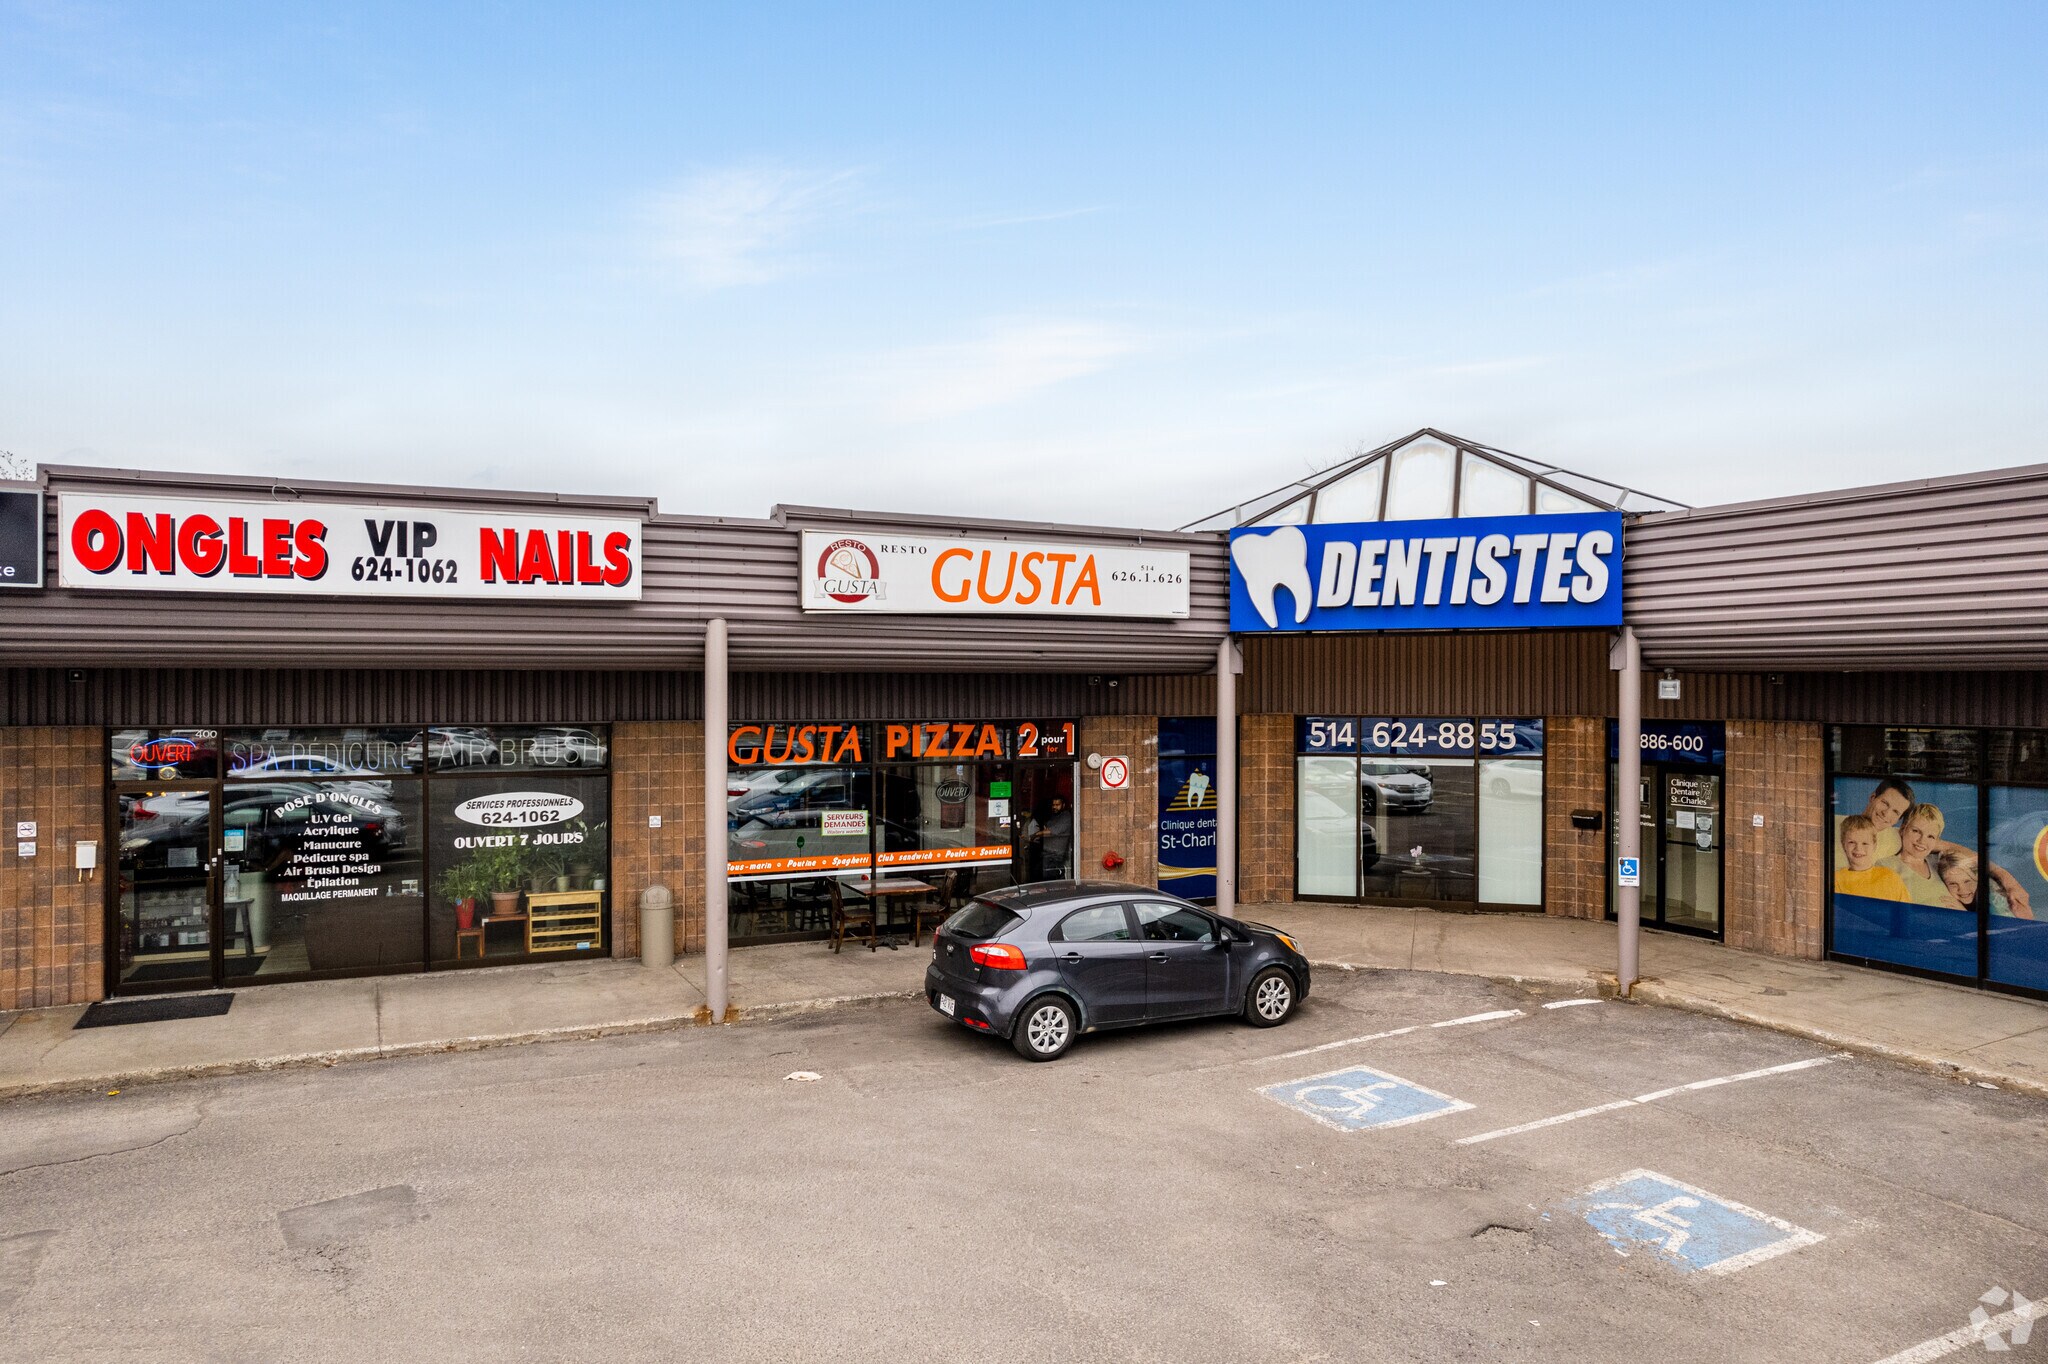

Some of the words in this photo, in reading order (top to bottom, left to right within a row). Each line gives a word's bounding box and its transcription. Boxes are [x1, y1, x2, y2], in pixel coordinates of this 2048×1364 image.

[364, 518, 438, 559] VIP
[830, 540, 866, 552] RESTO
[71, 509, 328, 580] ONGLES
[480, 527, 632, 587] NAILS
[881, 544, 927, 555] RESTO
[351, 556, 458, 583] 624-1062
[1317, 530, 1614, 607] DENTISTES
[931, 547, 1102, 606] GUSTA
[1112, 571, 1182, 583] 626.1.626
[824, 579, 878, 594] GUSTA
[195, 729, 217, 739] 400
[1018, 722, 1038, 757] 2
[1041, 736, 1065, 746] pour
[1062, 722, 1075, 756] 1
[1309, 722, 1355, 747] 514
[1372, 722, 1517, 749] 624-8855
[728, 725, 862, 765] GUSTA
[887, 722, 1004, 759] PIZZA
[1640, 733, 1703, 751] 886-600
[130, 744, 193, 762] OUVERT
[232, 743, 279, 773] SPA
[438, 737, 487, 767] AIR
[501, 737, 600, 767] BRUSH
[1671, 779, 1698, 789] Clinique
[1671, 787, 1700, 796] Dentaire
[940, 787, 968, 797] OUVERT
[274, 795, 313, 818] POSE
[316, 792, 382, 815] D'ONGLES
[466, 800, 505, 809] SERVICES
[506, 798, 574, 808] PROFESSIONNELS
[333, 814, 352, 822] Gel
[481, 810, 560, 824] 624-1062
[1161, 820, 1195, 831] Clinique
[1197, 818, 1218, 828] dent
[303, 825, 359, 837] Acrylique
[304, 841, 362, 850] Manucure
[454, 835, 515, 849] OUVERT
[520, 834, 529, 845] 7
[533, 832, 584, 845] JOURS
[1161, 831, 1216, 849] St-Charl
[293, 853, 346, 863] Pédicure
[349, 853, 369, 861] spa
[787, 859, 816, 867] Poutine
[832, 856, 869, 866] Spaghetti
[877, 854, 894, 862] Club
[898, 851, 933, 861] sandwich
[945, 849, 968, 858] Poulet
[980, 847, 1010, 856] Souvlaki
[284, 866, 302, 876] Air
[305, 865, 340, 875] Brush
[342, 863, 381, 874] Design
[307, 876, 359, 889] Épilation
[281, 891, 331, 902] MAQUILLAGE
[333, 887, 379, 898] PERMANENT
